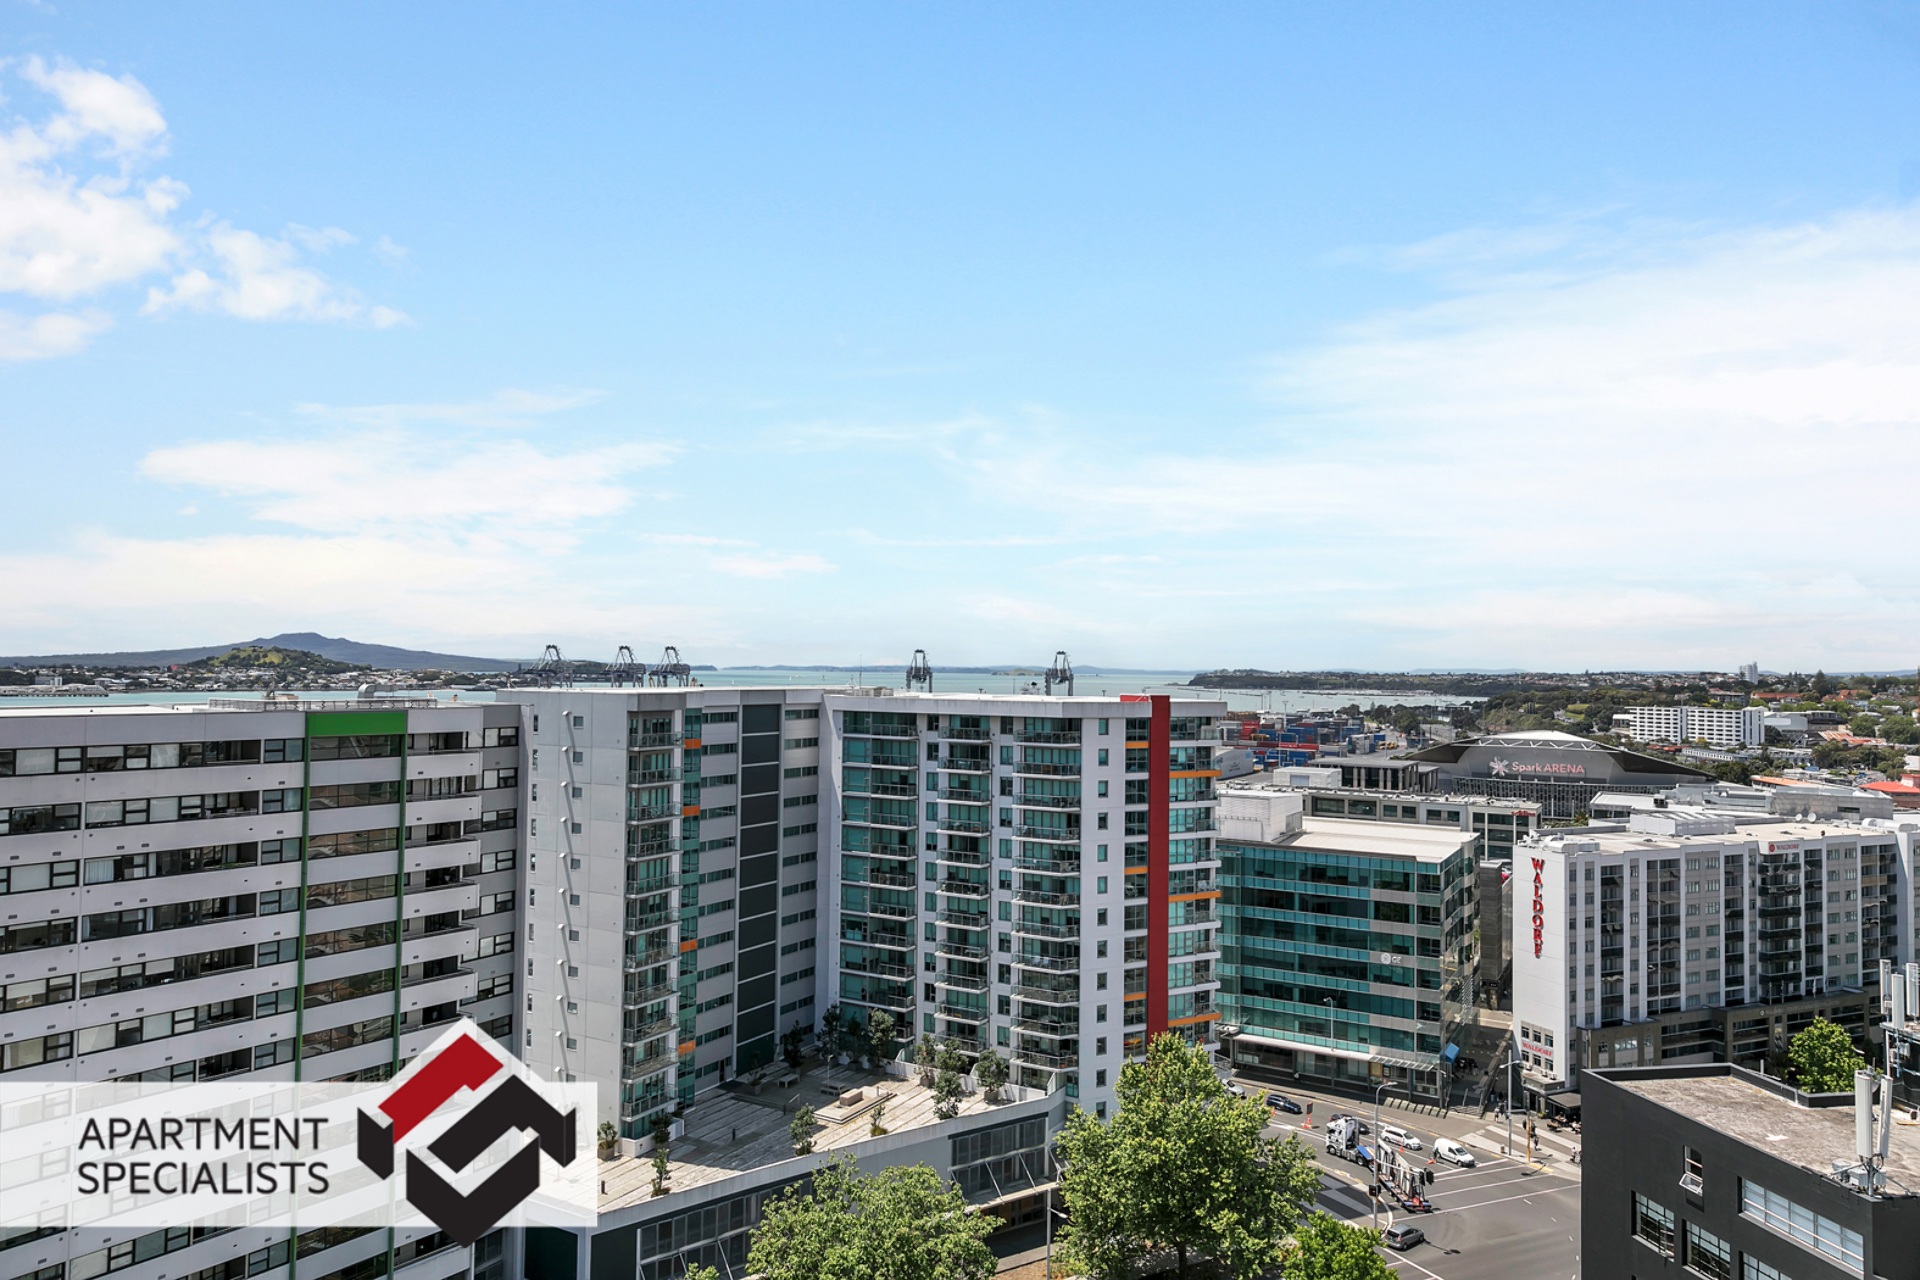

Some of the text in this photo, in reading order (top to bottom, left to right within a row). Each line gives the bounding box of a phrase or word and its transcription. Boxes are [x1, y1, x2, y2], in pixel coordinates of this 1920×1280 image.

[1512, 761, 1585, 774] Spark ARENA
[1531, 857, 1545, 958] WALDORF
[1522, 1041, 1552, 1057] WALDORF
